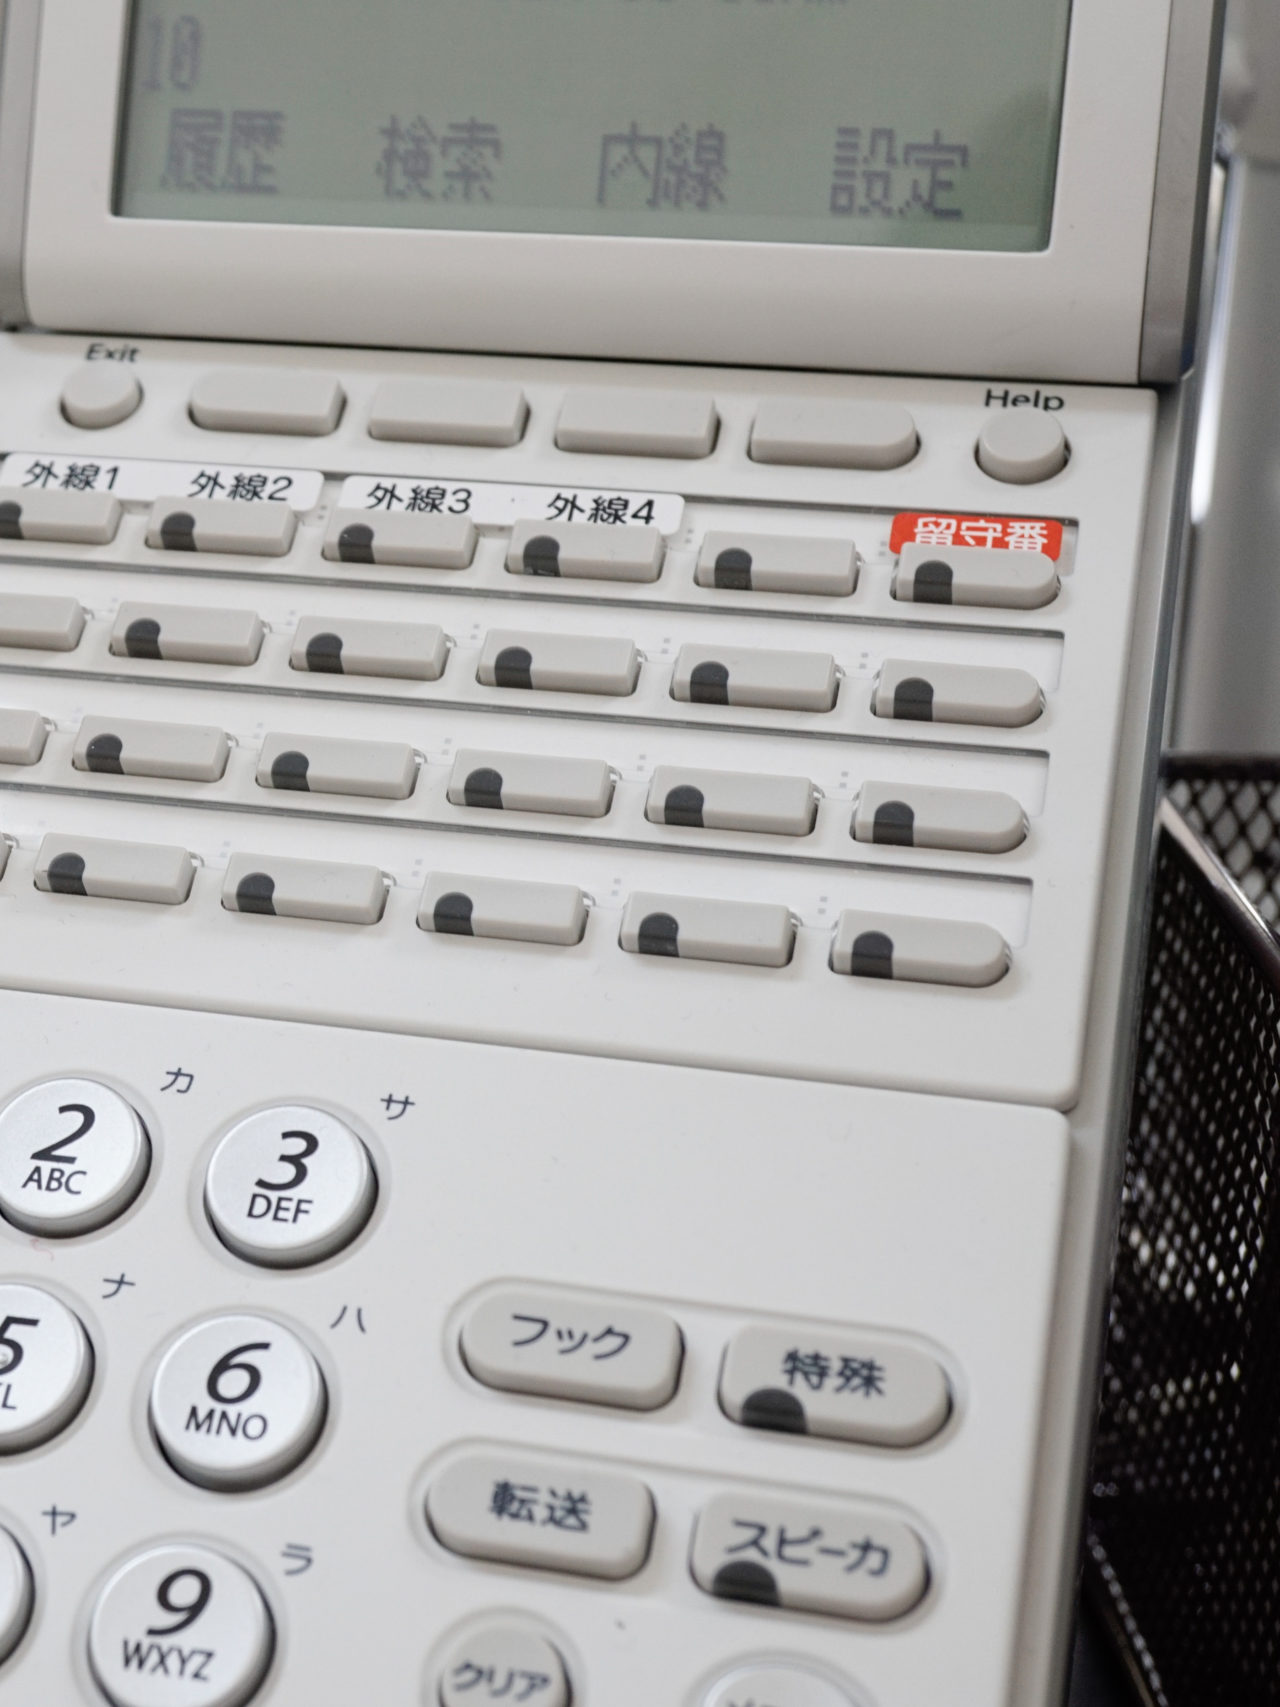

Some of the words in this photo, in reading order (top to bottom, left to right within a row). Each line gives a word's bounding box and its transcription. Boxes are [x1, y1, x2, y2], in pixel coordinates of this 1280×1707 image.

[159, 107, 286, 195] 履歴
[375, 115, 503, 203] 検索
[596, 122, 728, 212] 内線
[829, 126, 970, 219] 設定
[85, 343, 141, 363] Exit
[984, 388, 1065, 412] Help
[21, 460, 120, 491] 外線1
[187, 469, 294, 501] 外線2
[365, 482, 473, 514] 外線3
[545, 493, 655, 525] 外線4
[913, 516, 1048, 551] 留守番
[160, 1067, 195, 1094] カ
[380, 1092, 415, 1120] サ
[30, 1103, 96, 1165] 2
[21, 1165, 87, 1195] ABC
[254, 1130, 319, 1192] 3
[246, 1192, 313, 1225] DEF
[102, 1273, 136, 1299] ナ
[330, 1305, 366, 1333] ハ
[510, 1313, 632, 1361] フック
[206, 1342, 272, 1405] 6
[782, 1347, 886, 1400] 特殊
[185, 1405, 269, 1441] MNO
[41, 1504, 77, 1536] ヤ
[489, 1479, 593, 1534] 転送
[280, 1542, 314, 1576] ラ
[724, 1518, 891, 1578] スピーカ
[146, 1567, 213, 1637] 9
[121, 1637, 215, 1681] WXYZ
[451, 1658, 551, 1703] クリア
